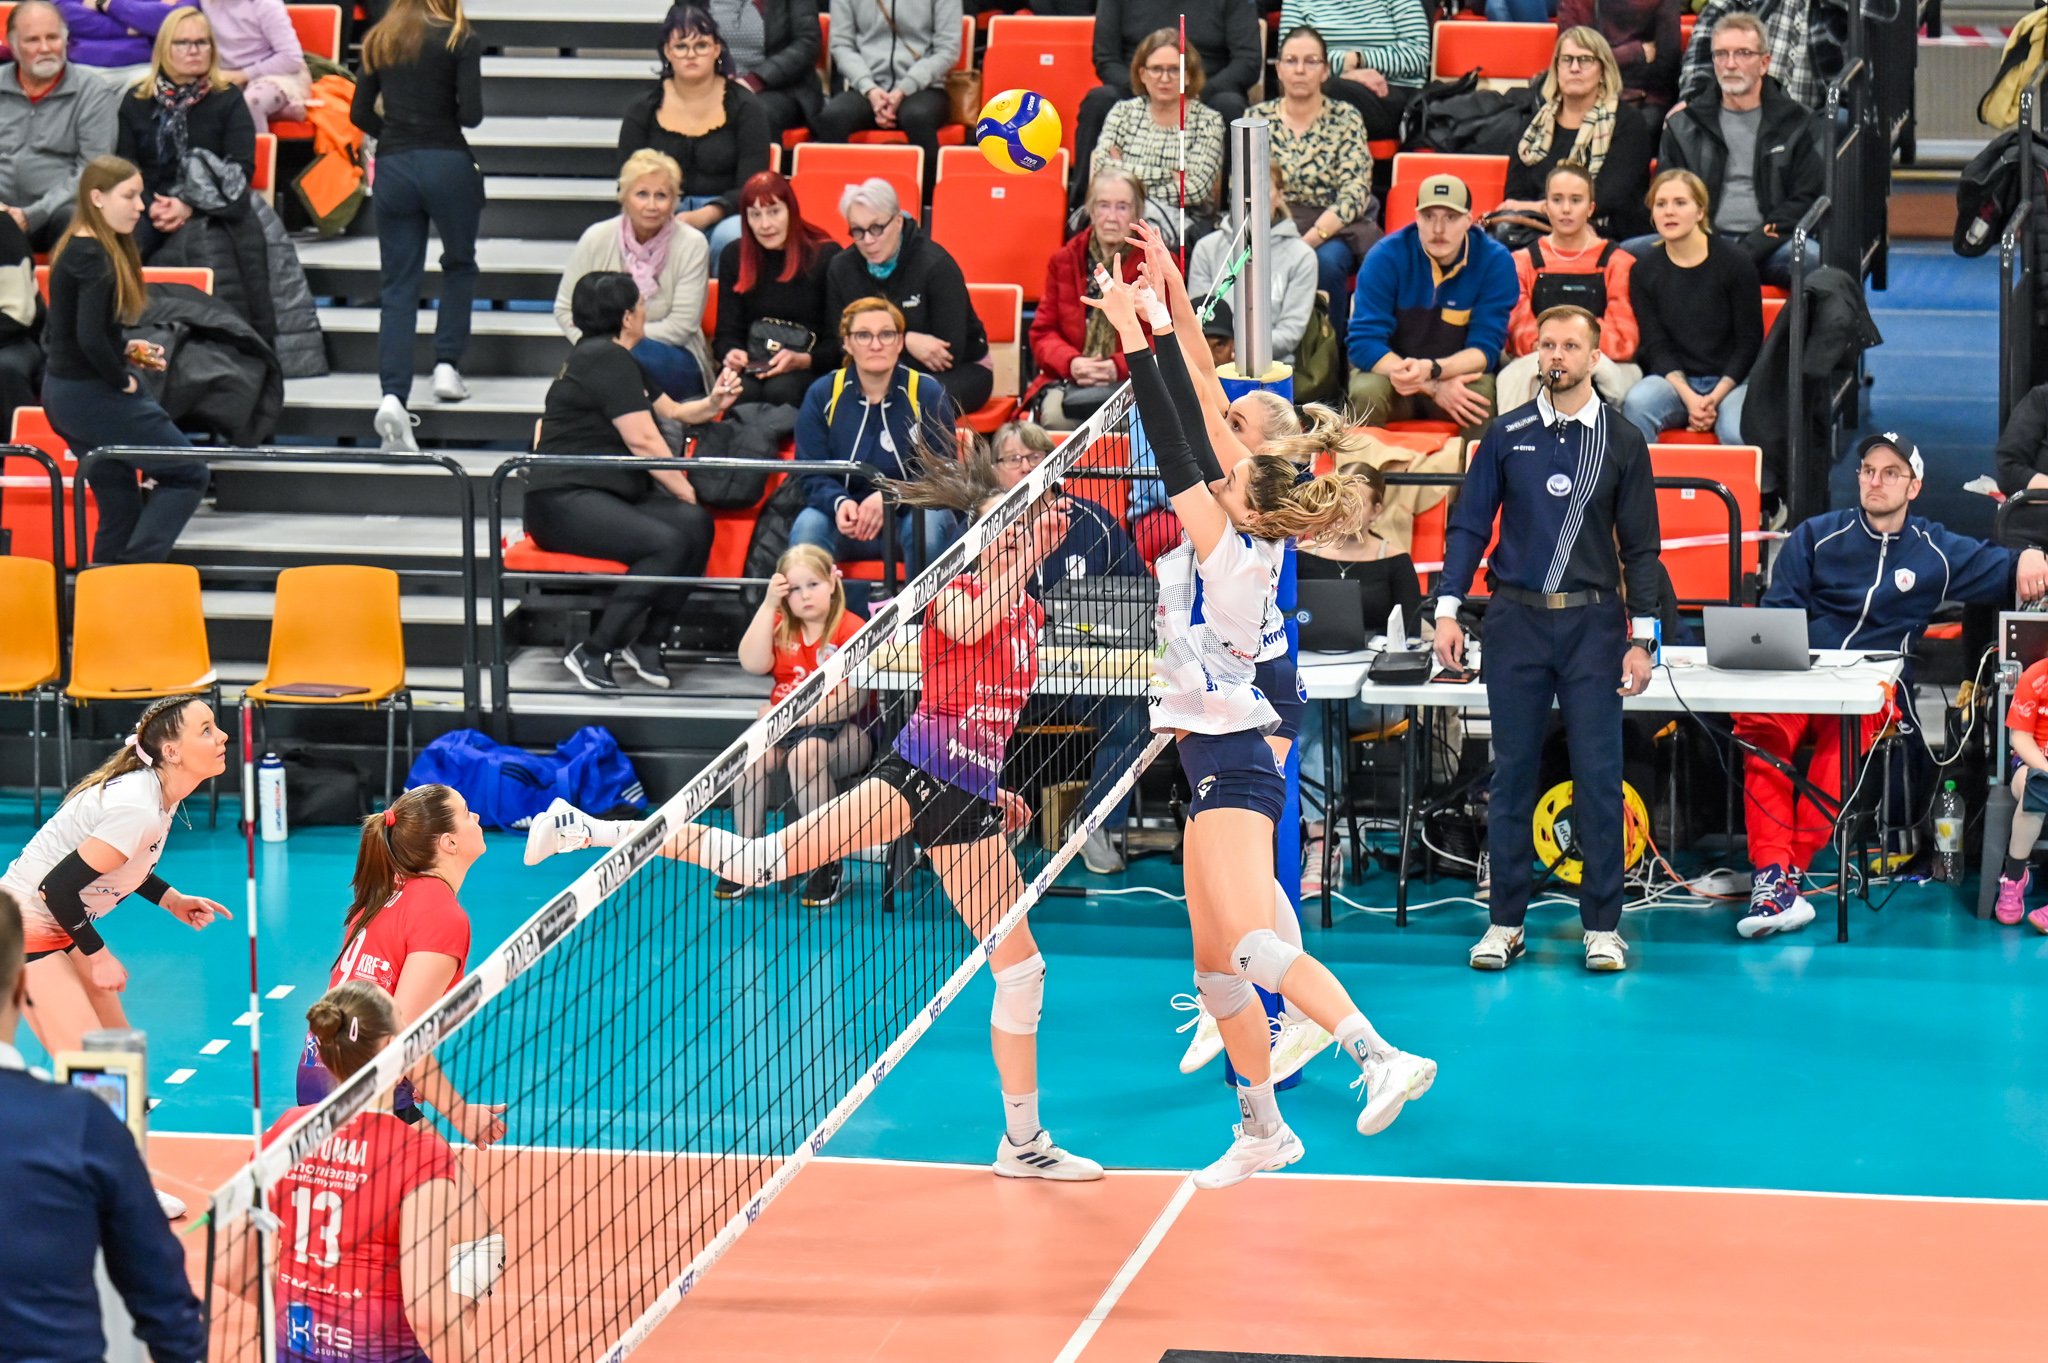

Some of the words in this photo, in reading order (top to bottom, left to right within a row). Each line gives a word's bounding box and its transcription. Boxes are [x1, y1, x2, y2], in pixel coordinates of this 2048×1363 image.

[1043, 451, 1066, 489] TAIGA
[980, 508, 1004, 551] TAIGA
[913, 569, 939, 613] TAIGA
[842, 633, 871, 678] TAIGA
[765, 701, 795, 749] TAIGA
[683, 772, 715, 824] TAIGA
[595, 848, 631, 899] TAIGA
[503, 927, 541, 983] TAIGA
[401, 1014, 440, 1077] TAIGA
[289, 1162, 368, 1184] noniemen
[291, 1186, 343, 1268] 13
[291, 1317, 353, 1350] KAS
